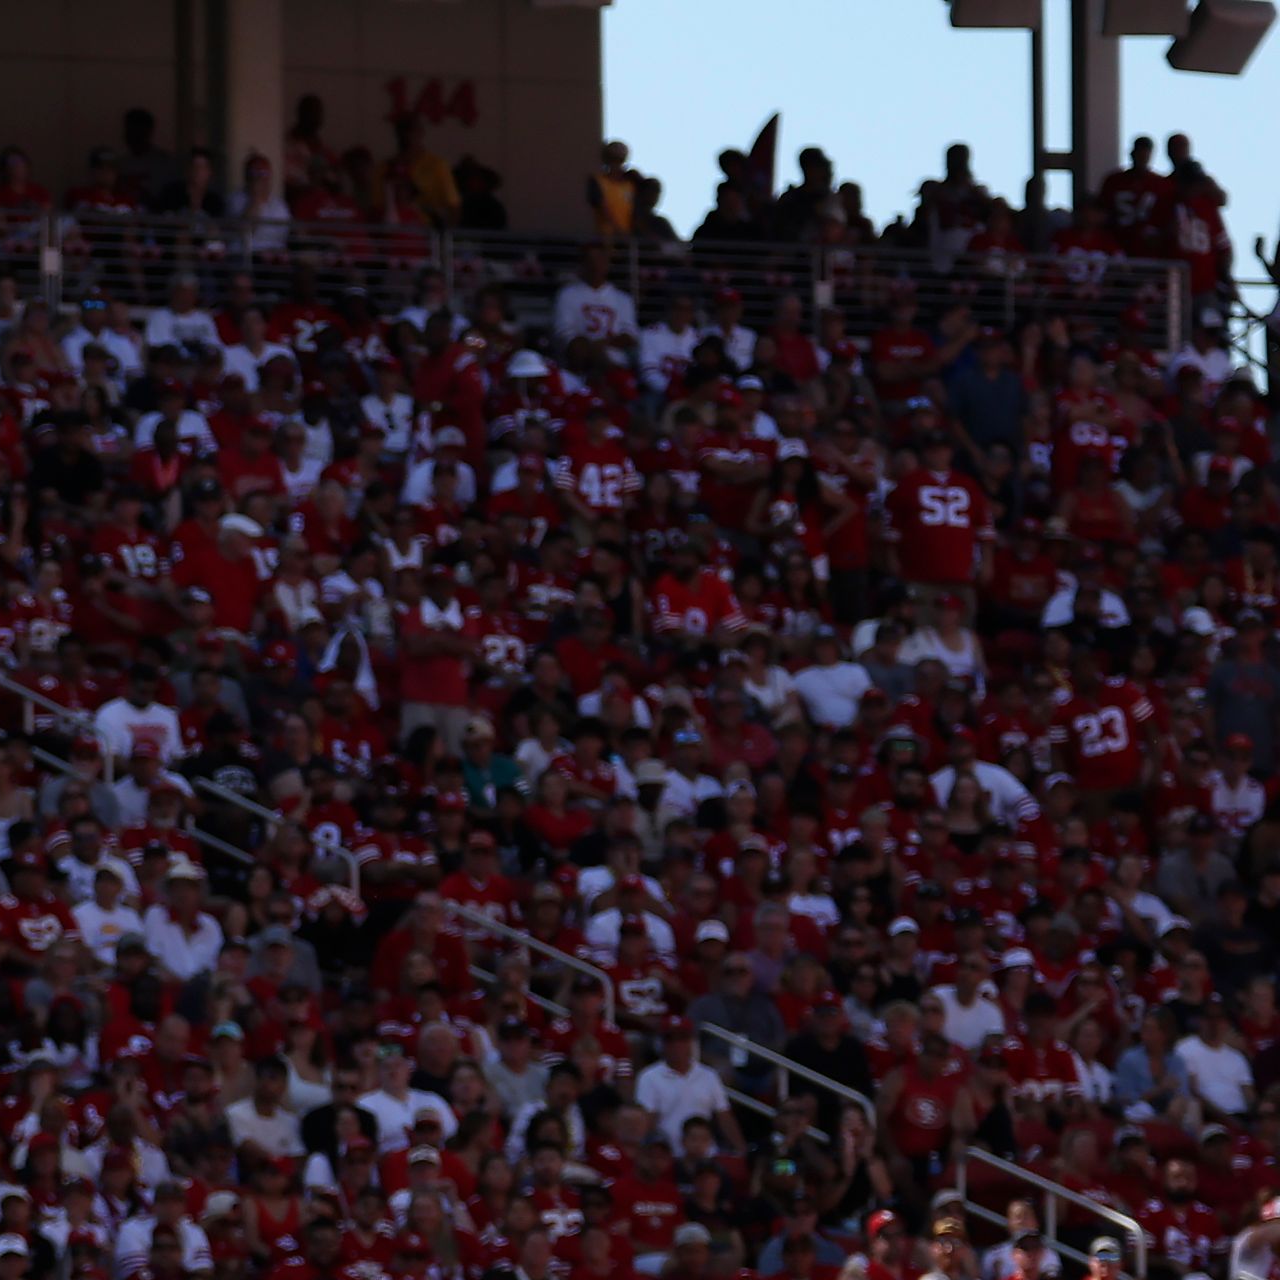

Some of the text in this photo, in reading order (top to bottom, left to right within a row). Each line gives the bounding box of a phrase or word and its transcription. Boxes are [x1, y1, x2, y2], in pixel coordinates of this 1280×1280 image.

[389, 77, 476, 126] 144
[579, 463, 624, 509] 42
[917, 485, 970, 528] 52
[117, 542, 157, 579] 19
[1073, 706, 1129, 759] 23
